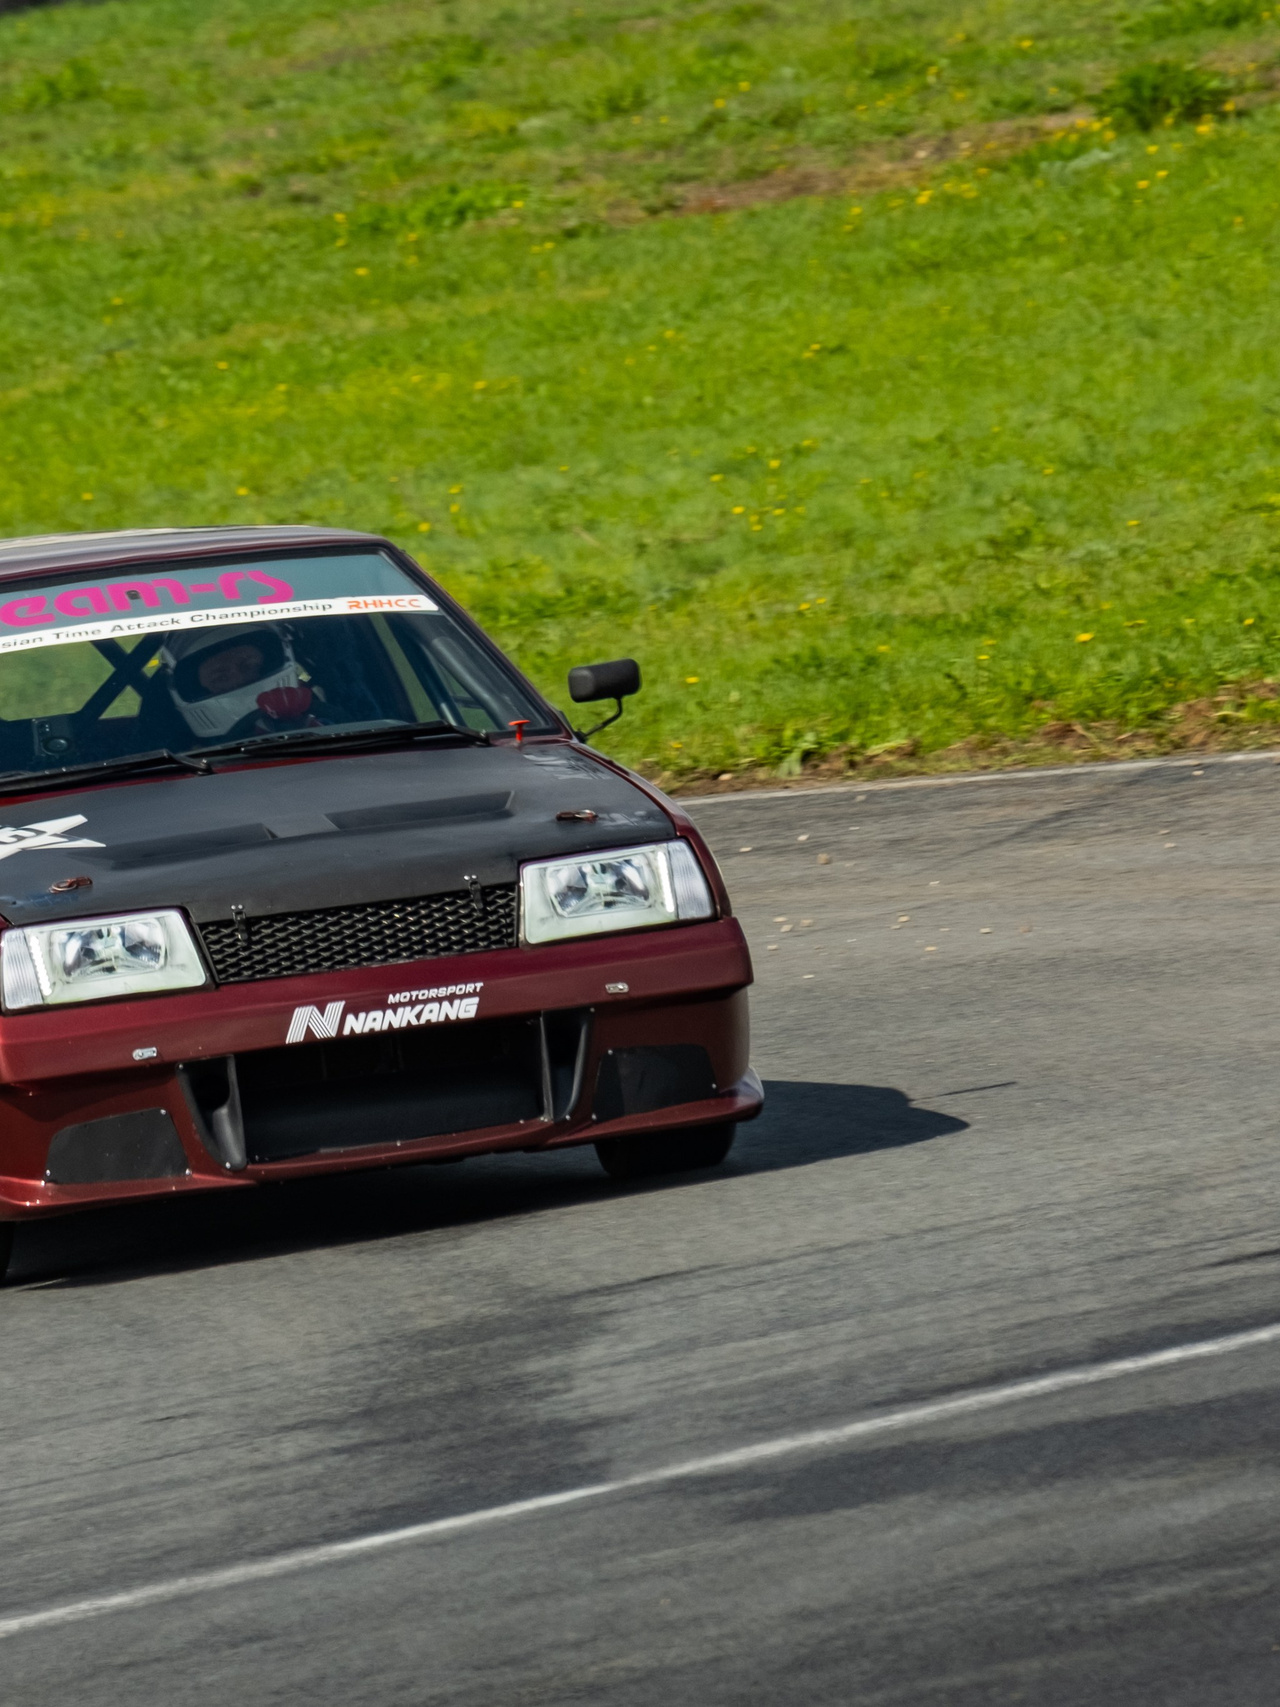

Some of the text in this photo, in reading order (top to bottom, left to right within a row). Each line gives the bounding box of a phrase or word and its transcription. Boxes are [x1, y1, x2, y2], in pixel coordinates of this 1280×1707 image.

[52, 626, 102, 640] Time
[111, 616, 181, 633] Attack
[190, 602, 333, 623] Championship
[347, 599, 423, 610] RHHCC
[388, 982, 484, 1004] MOTORSPORT
[343, 997, 480, 1036] NANKANG
